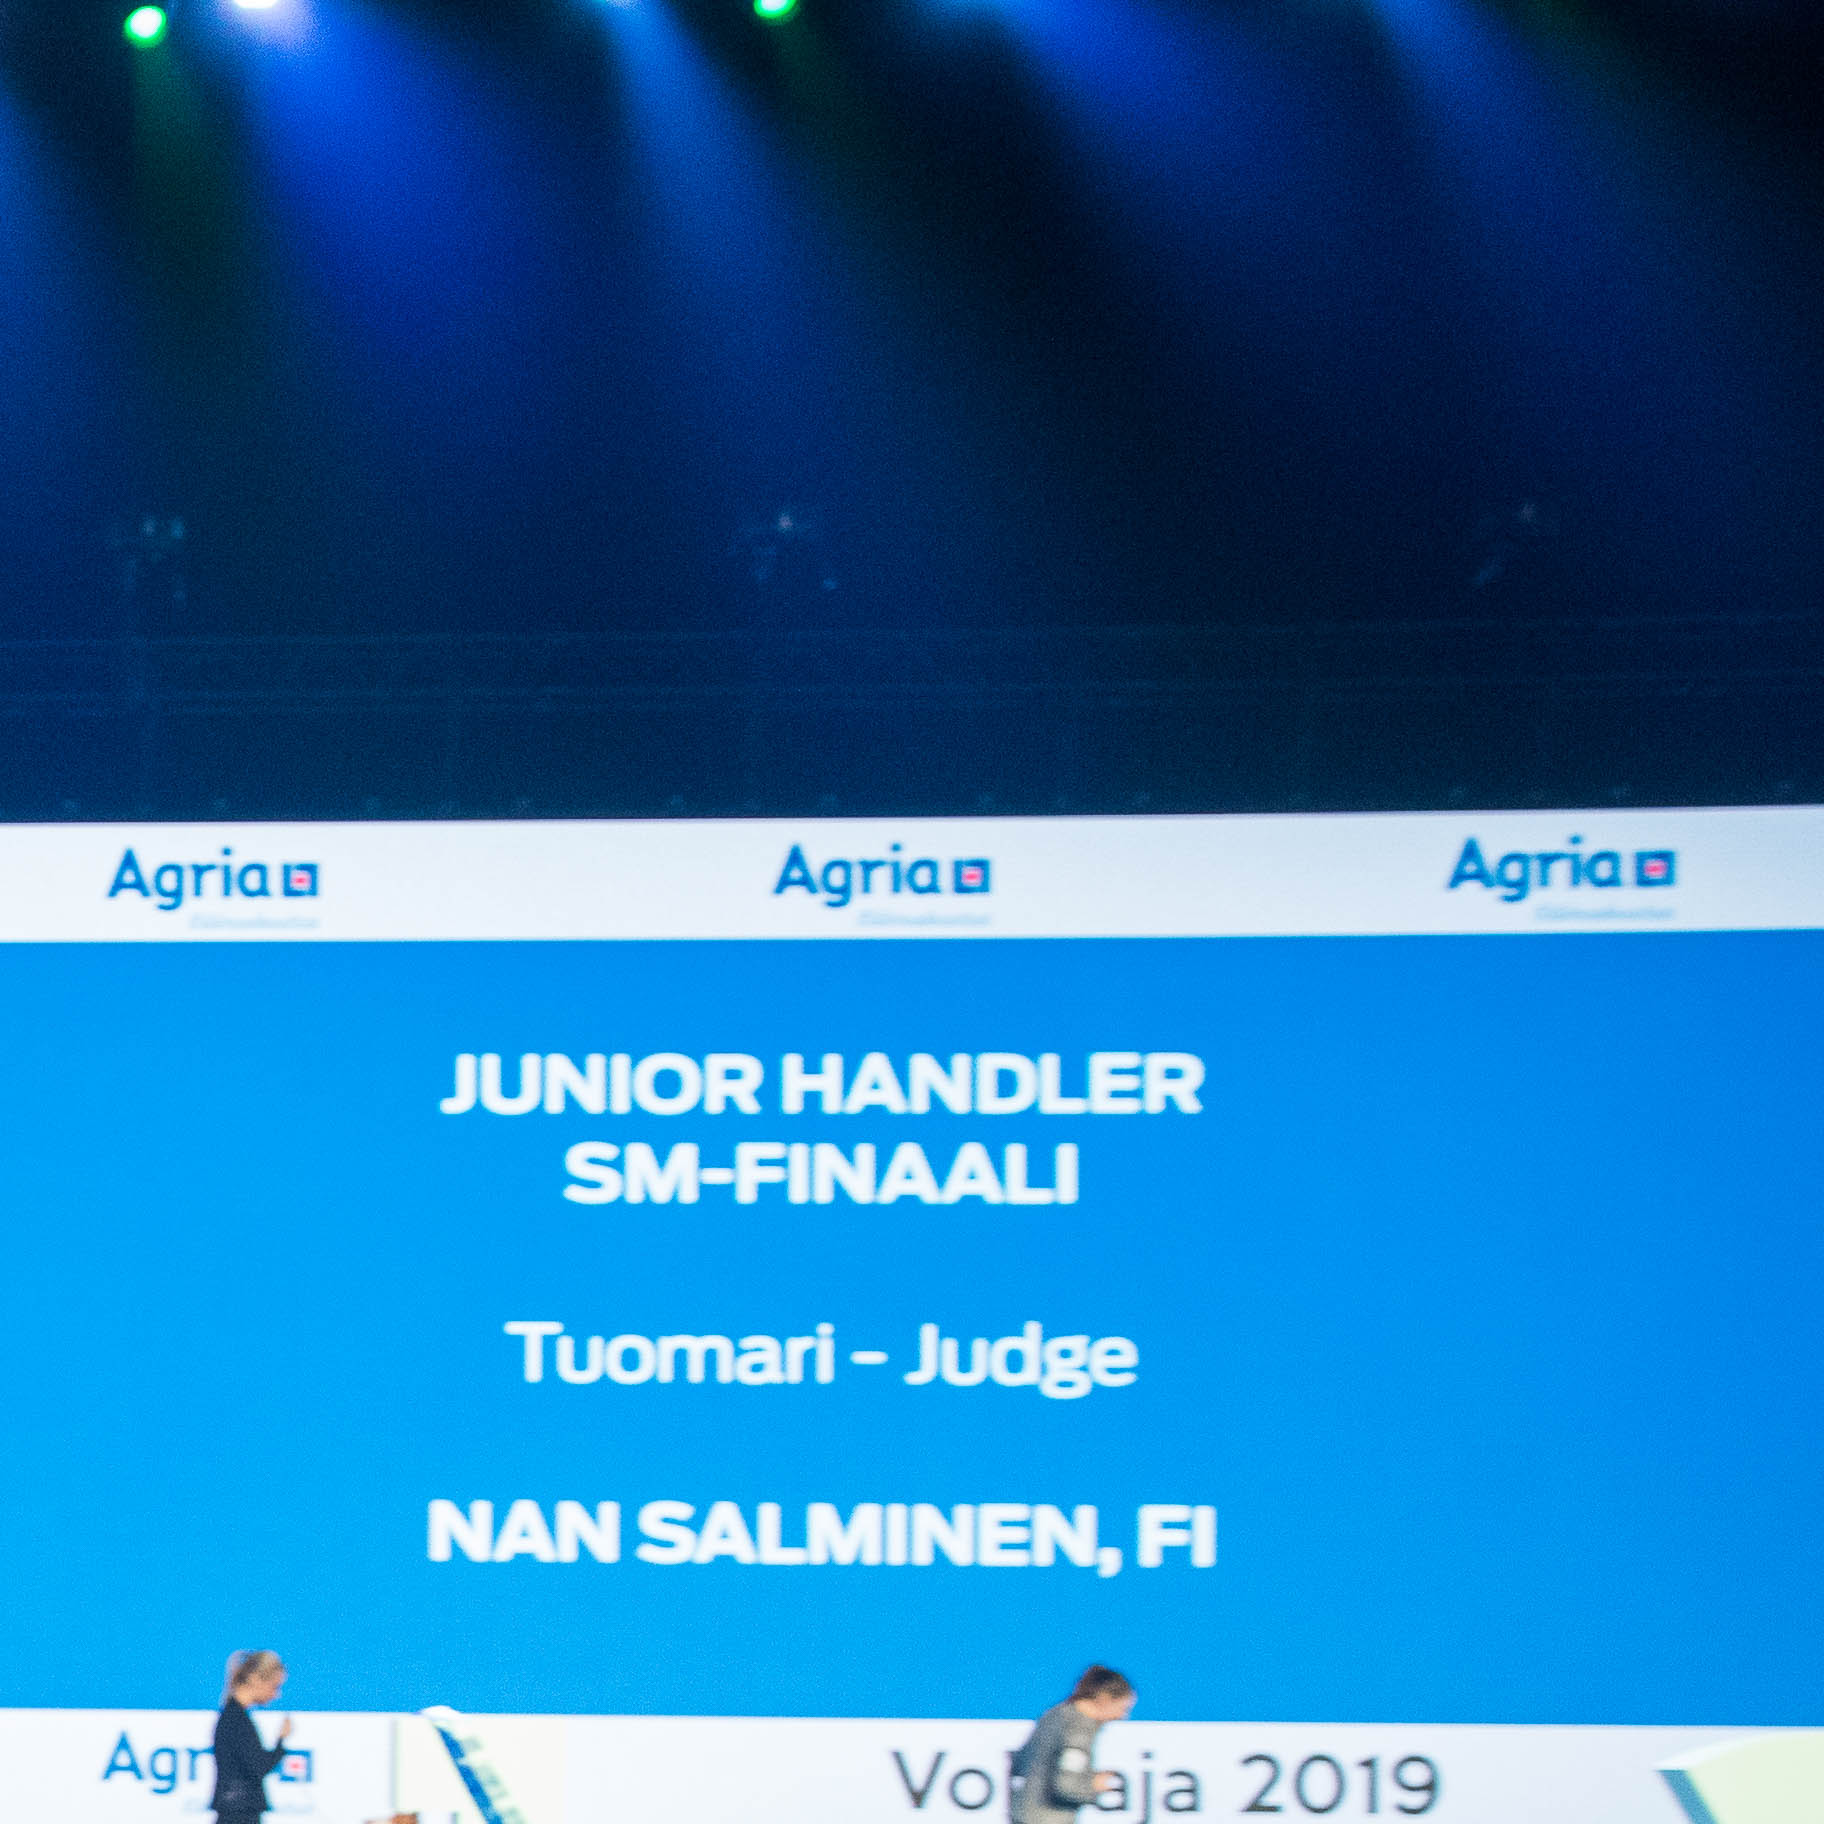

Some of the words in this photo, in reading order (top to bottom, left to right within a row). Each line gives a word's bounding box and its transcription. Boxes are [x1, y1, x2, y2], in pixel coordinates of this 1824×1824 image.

[107, 847, 271, 911] Agria
[772, 843, 941, 908] Agria
[1447, 835, 1622, 903] Agria
[438, 1052, 764, 1116] JUNIOR
[782, 1051, 1206, 1115] HANDLER
[563, 1141, 1079, 1205] SM-FINAALI
[503, 1320, 836, 1386] Tuomari
[903, 1320, 1140, 1400] Judge
[427, 1498, 621, 1564] NAN
[636, 1500, 1123, 1578] SALMINEN,
[1137, 1503, 1218, 1569] FI
[101, 1729, 216, 1795] Agr
[1239, 1753, 1441, 1815] 2019
